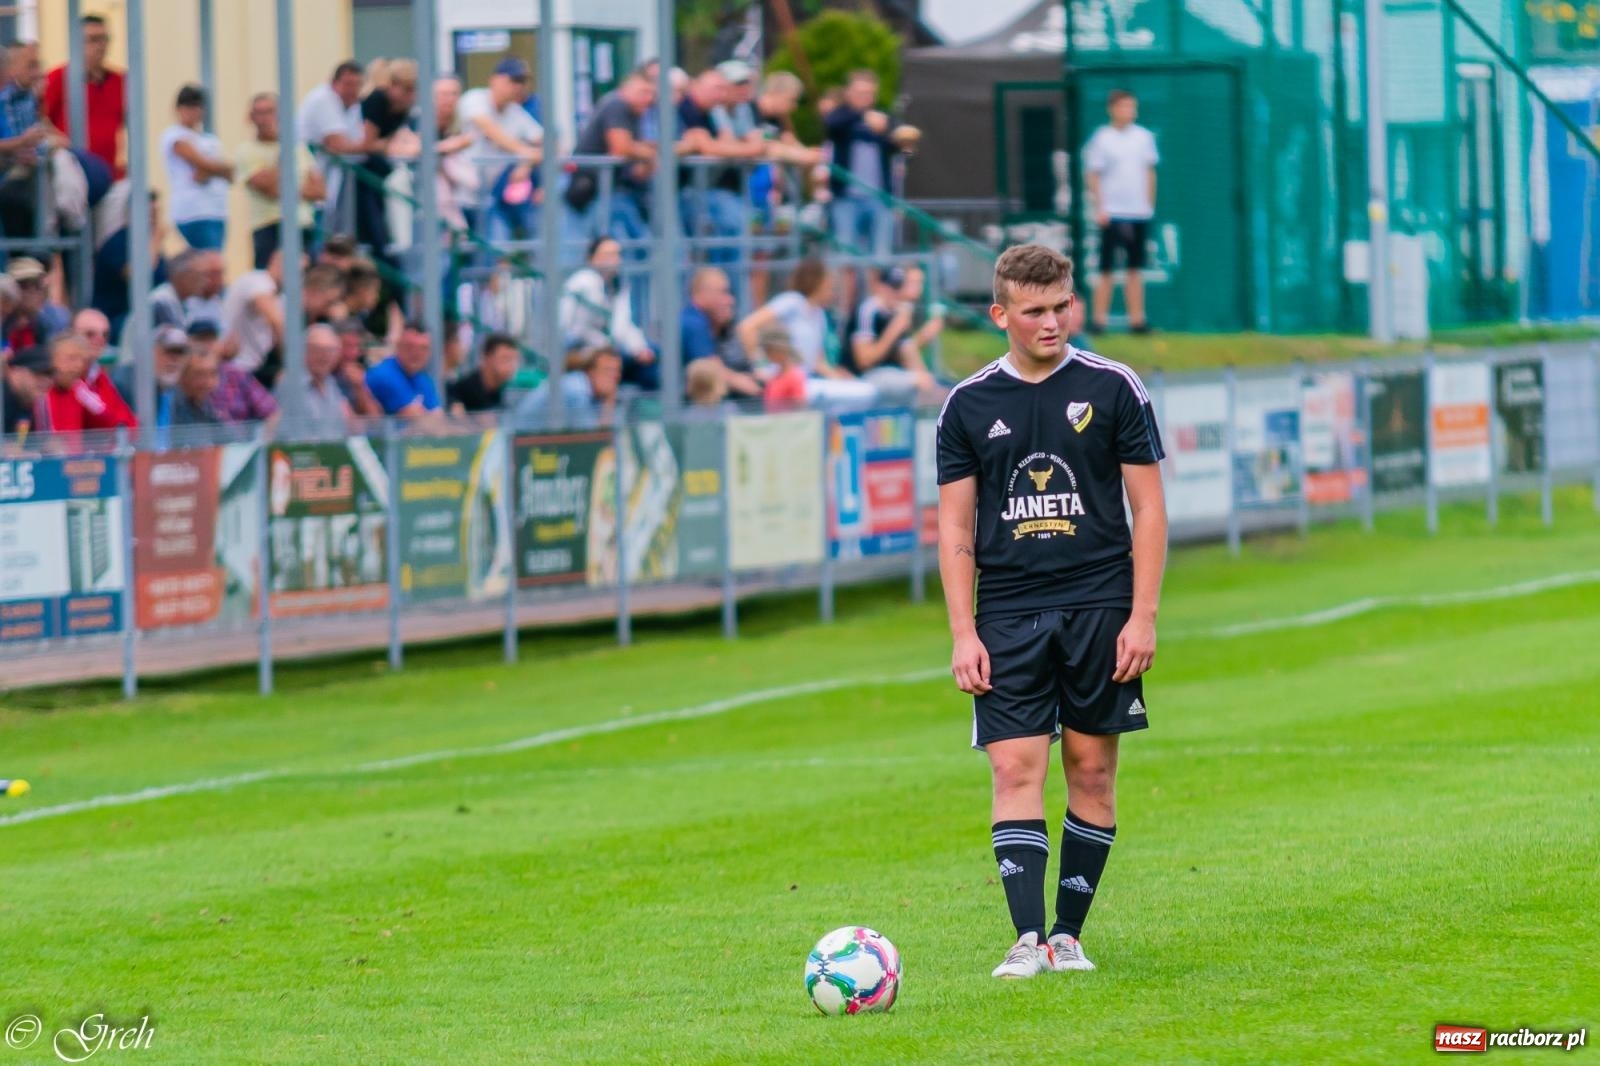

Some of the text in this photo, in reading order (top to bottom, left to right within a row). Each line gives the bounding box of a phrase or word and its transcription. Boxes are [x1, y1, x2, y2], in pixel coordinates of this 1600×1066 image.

[988, 428, 1011, 438] adidas
[1001, 492, 1086, 520] JANETA
[1061, 880, 1094, 894] adidas
